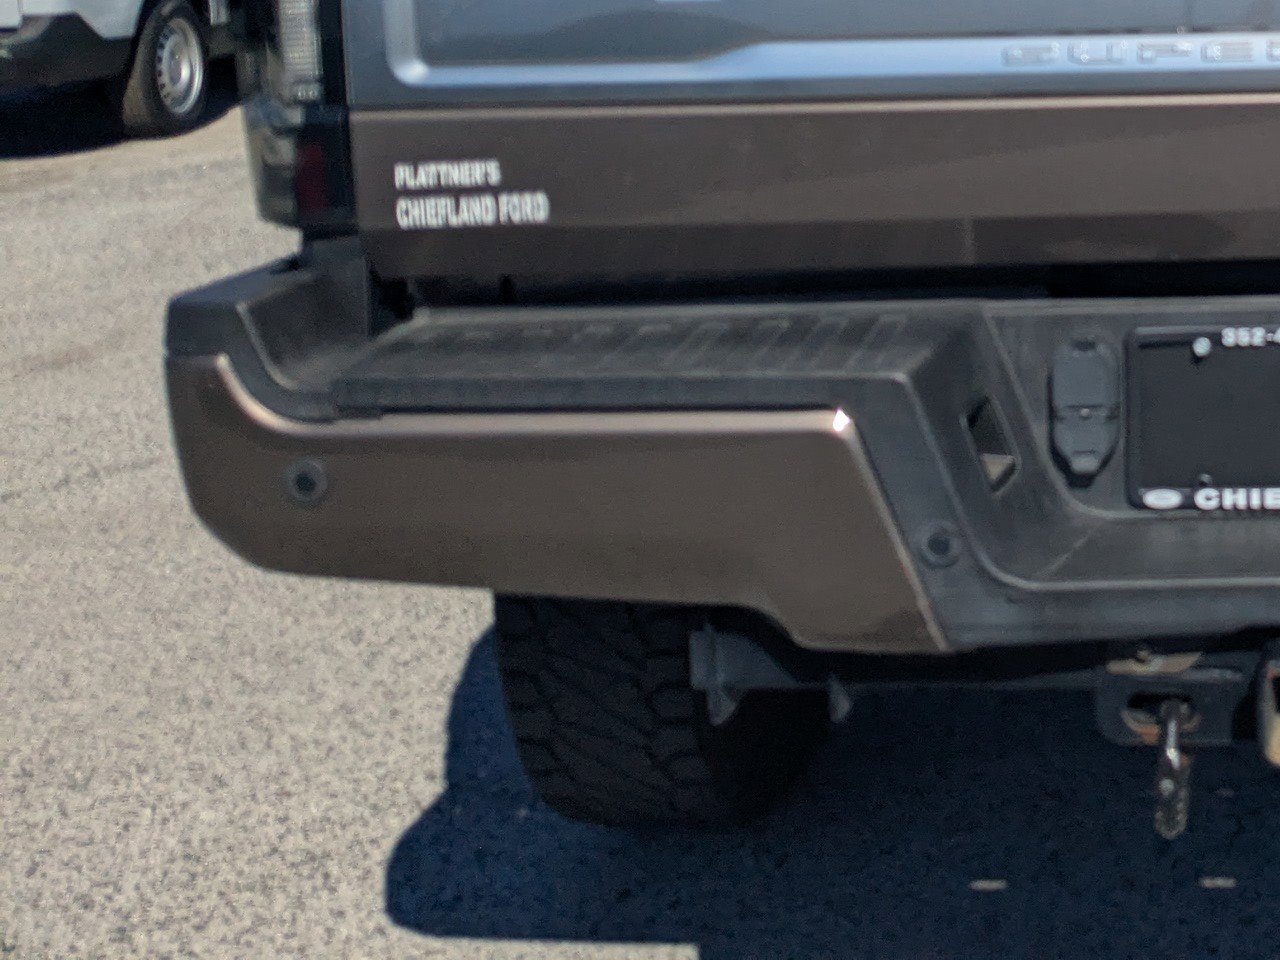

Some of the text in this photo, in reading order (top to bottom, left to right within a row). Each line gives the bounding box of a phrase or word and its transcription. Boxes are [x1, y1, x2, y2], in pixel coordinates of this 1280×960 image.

[395, 159, 501, 190] PLATTNER'S
[396, 191, 550, 230] CHIEFLAND FORD
